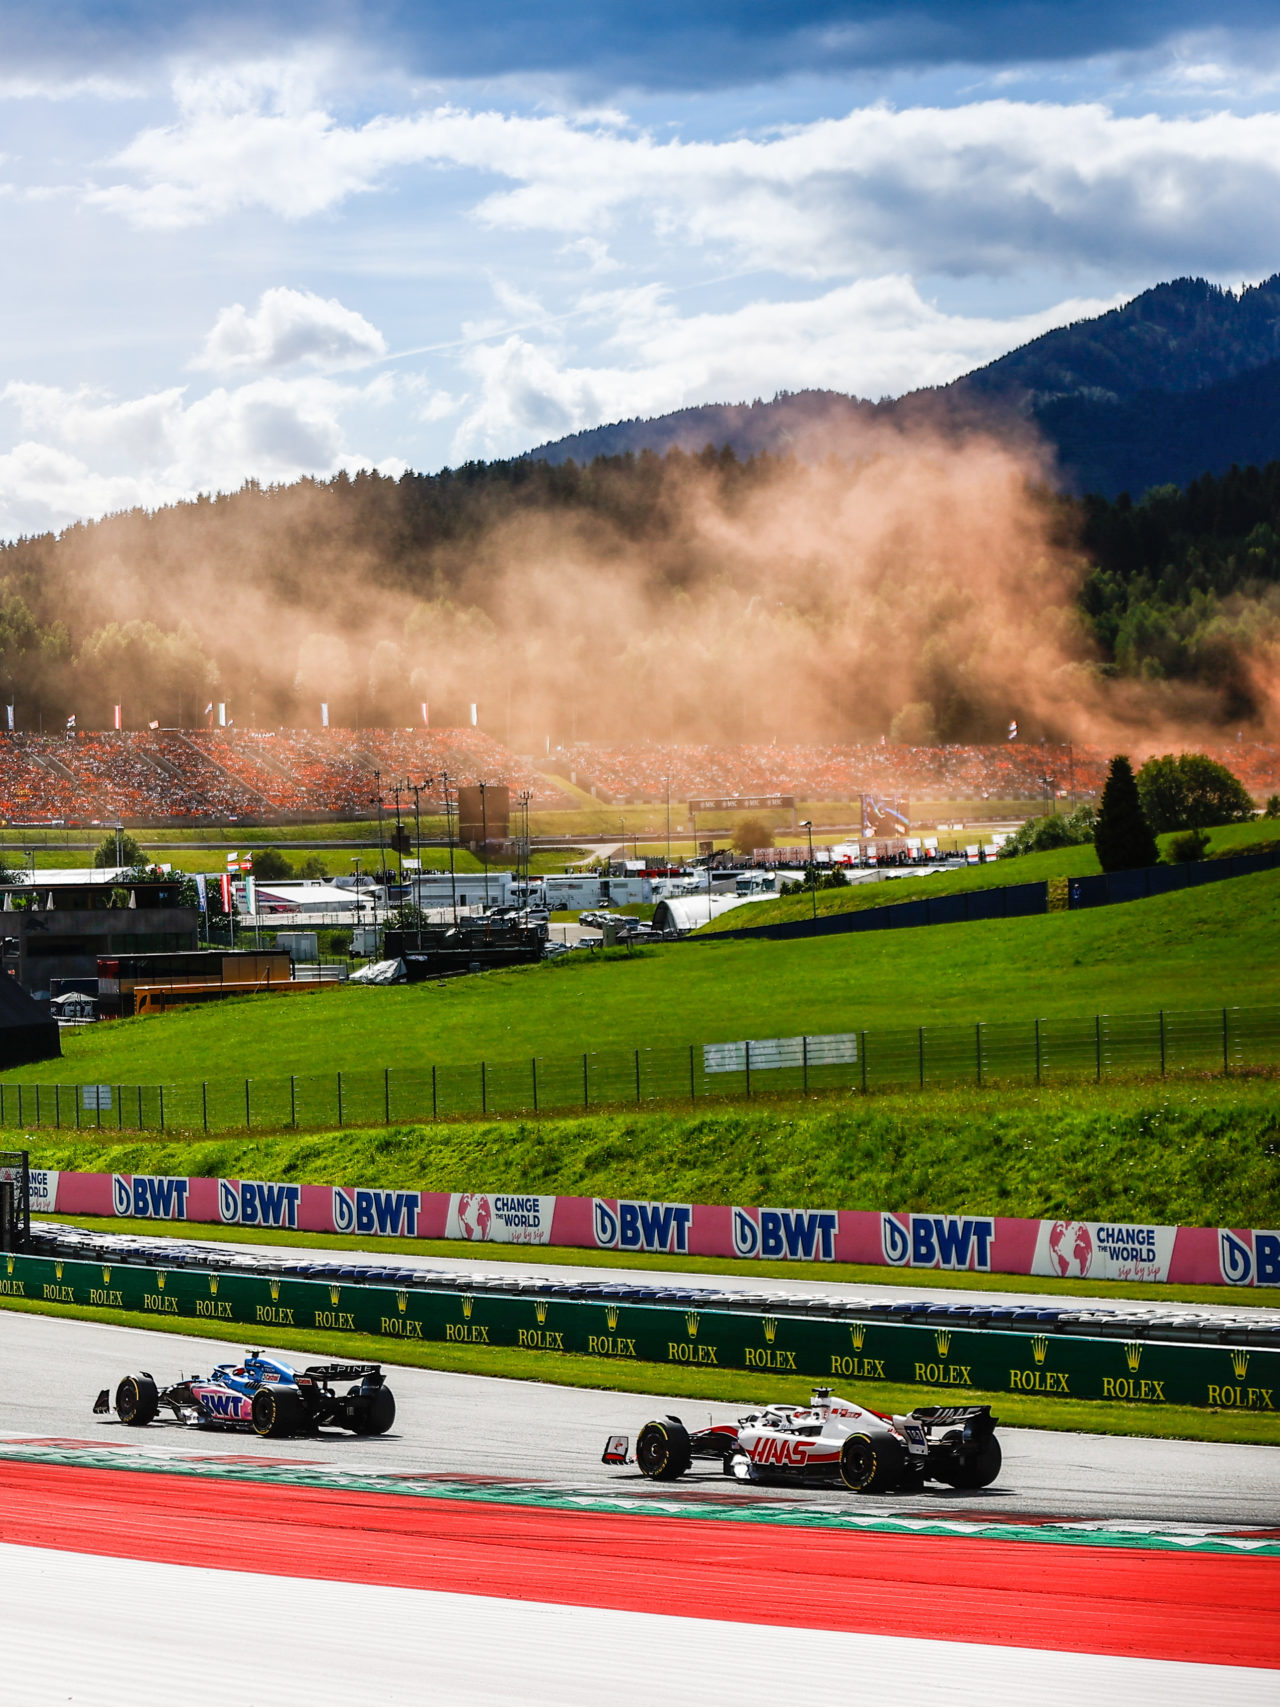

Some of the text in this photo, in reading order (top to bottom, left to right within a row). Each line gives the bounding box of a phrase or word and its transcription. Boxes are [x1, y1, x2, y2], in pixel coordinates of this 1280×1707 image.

[133, 1178, 187, 1219] BWT
[240, 1182, 298, 1227] BWT
[494, 1198, 540, 1213] CHANGE
[356, 1188, 420, 1236] BWT
[504, 1214, 540, 1228] WORLD
[620, 1202, 691, 1253] BWT
[762, 1210, 837, 1261] BWT
[1097, 1227, 1156, 1246] CHANGE
[912, 1217, 992, 1271] BWT
[1109, 1246, 1156, 1262] WORLD
[43, 1284, 74, 1302] ROLEX
[90, 1289, 123, 1306] ROLEX
[144, 1294, 178, 1312] ROLEX
[196, 1300, 232, 1318] ROLEX
[256, 1306, 294, 1324] ROLEX
[315, 1312, 356, 1330] ROLEX
[381, 1318, 424, 1338] ROLEX
[446, 1324, 490, 1343] ROLEX
[518, 1329, 564, 1350] ROLEX
[588, 1336, 637, 1356] ROLEX
[668, 1342, 718, 1364] ROLEX
[316, 1364, 372, 1374] ALPINE
[745, 1348, 798, 1370] ROLEX
[831, 1356, 886, 1378] ROLEX
[914, 1362, 972, 1384] ROLEX
[1010, 1370, 1070, 1392] ROLEX
[1102, 1378, 1166, 1400] ROLEX
[1208, 1384, 1274, 1409] ROLEX
[746, 1437, 817, 1465] HAAS
